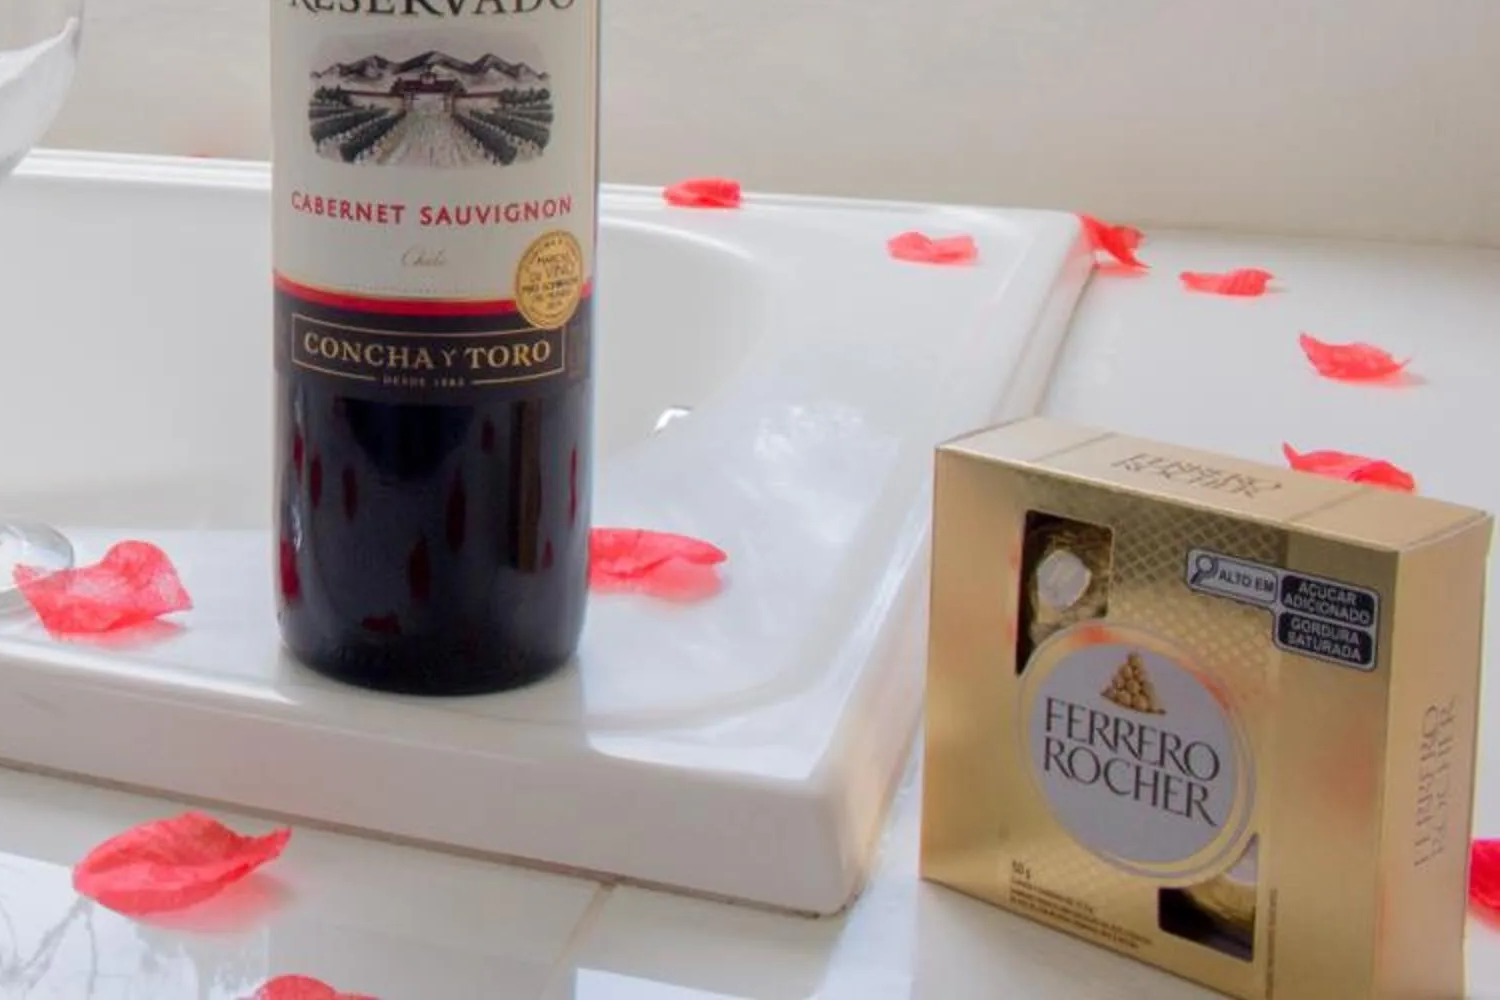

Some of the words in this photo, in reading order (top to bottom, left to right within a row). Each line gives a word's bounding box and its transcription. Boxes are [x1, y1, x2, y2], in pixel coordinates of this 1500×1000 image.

[291, 190, 406, 225] CABERNET
[419, 195, 573, 226] SAUVIGNON
[304, 332, 436, 371] CONCHA
[440, 350, 457, 368] Y
[464, 340, 551, 369] TORO
[1219, 569, 1251, 587] ALTO
[1255, 578, 1275, 593] EM
[1045, 696, 1221, 782] FERRERO
[1043, 735, 1218, 828] ROCHER
